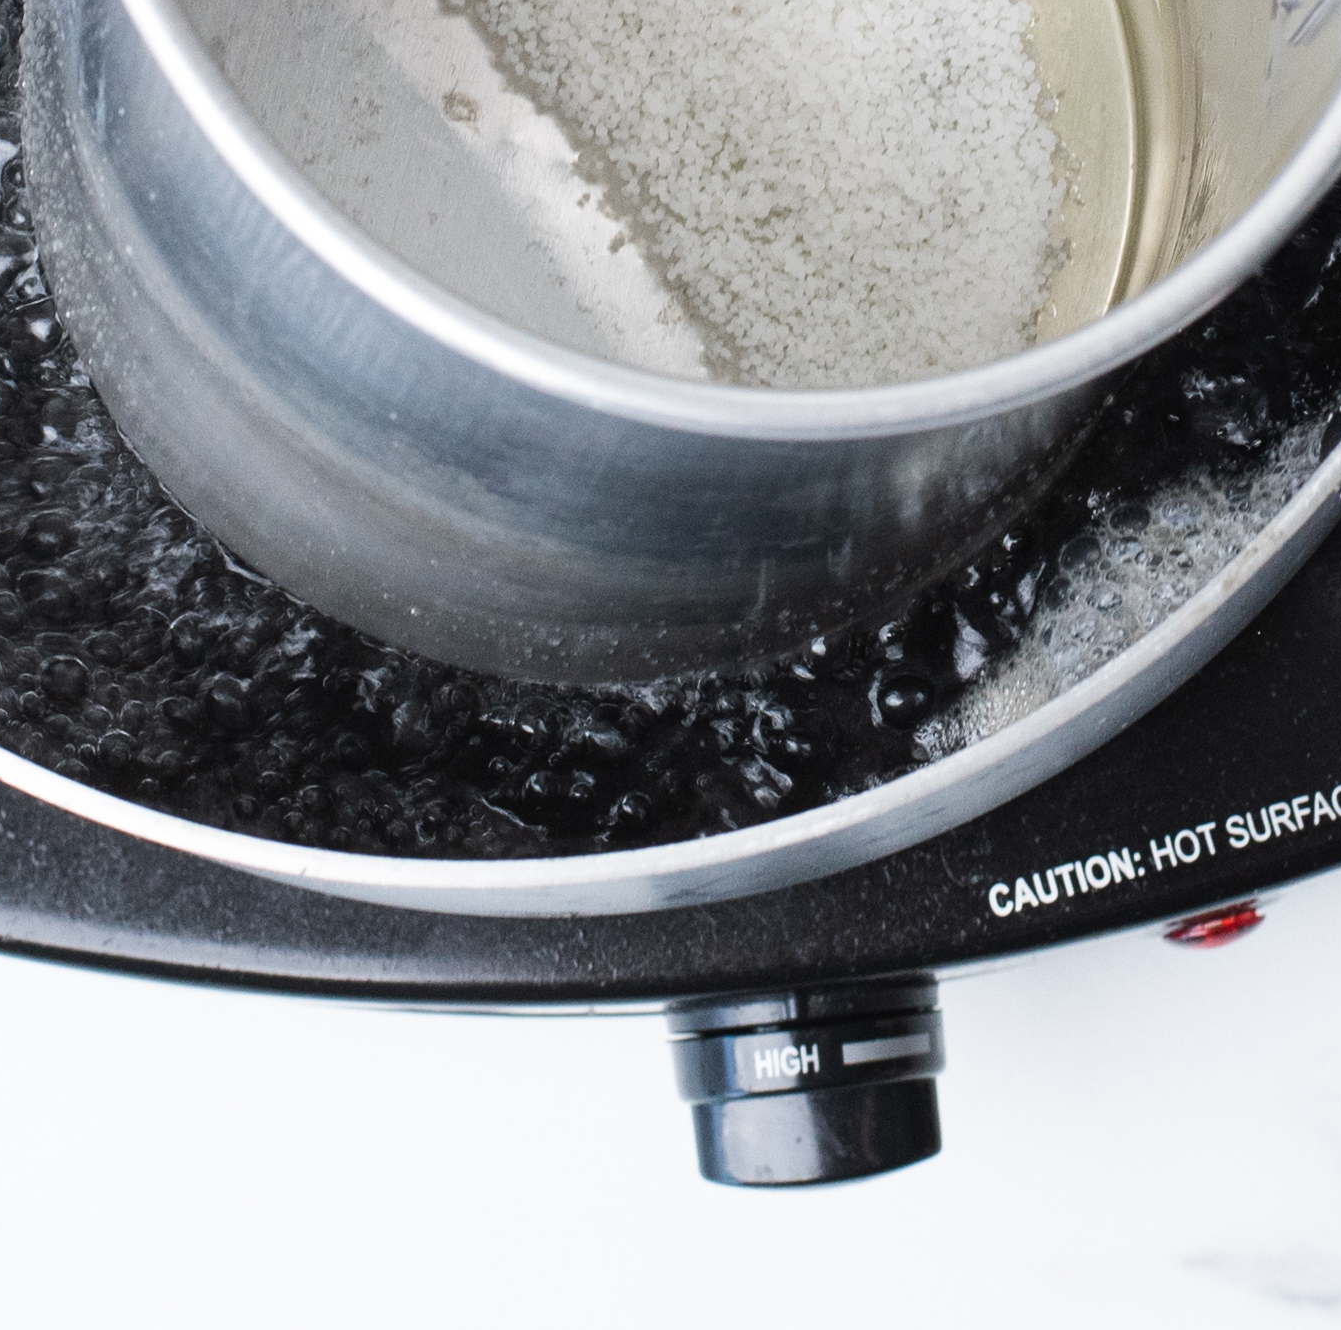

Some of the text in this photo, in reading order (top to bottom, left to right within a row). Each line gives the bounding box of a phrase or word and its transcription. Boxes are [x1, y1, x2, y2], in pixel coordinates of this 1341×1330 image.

[988, 847, 1146, 918] CAUTION:
[1149, 821, 1217, 872] HOT
[754, 1043, 820, 1080] HIGH
